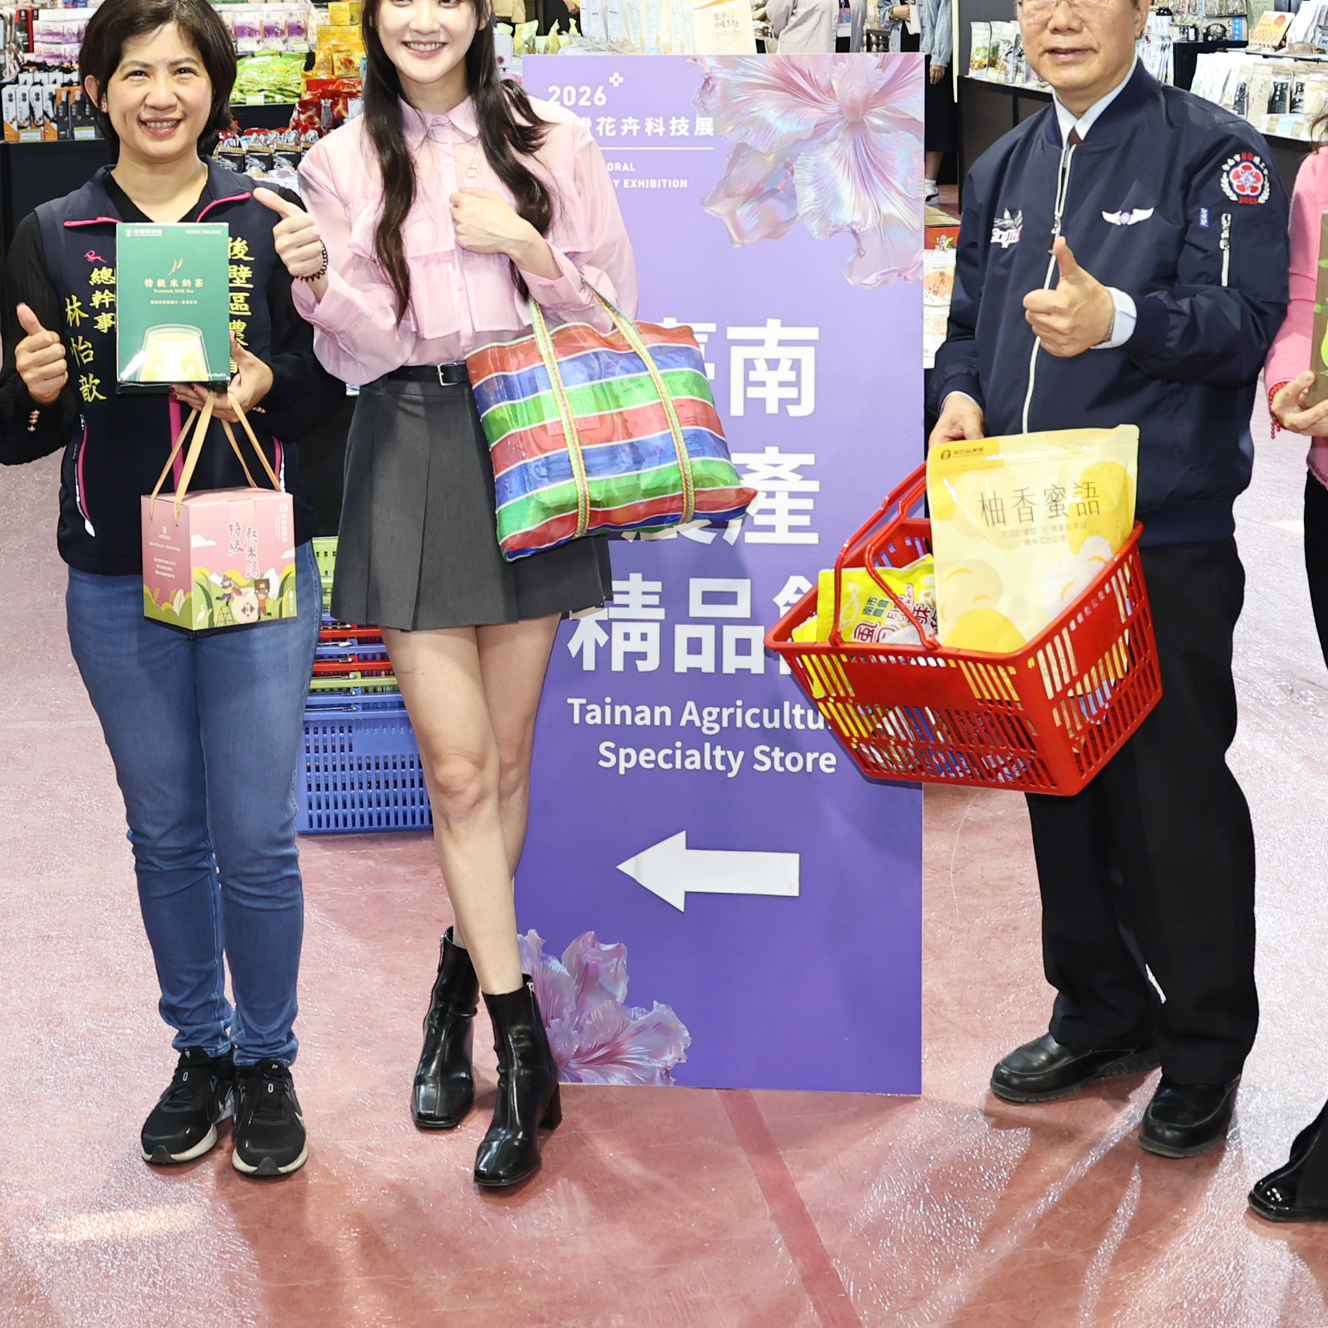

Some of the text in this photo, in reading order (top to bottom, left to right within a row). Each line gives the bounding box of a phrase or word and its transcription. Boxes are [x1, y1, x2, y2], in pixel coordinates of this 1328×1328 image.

[547, 85, 608, 107] 2026
[579, 116, 715, 137] 花卉科技展
[607, 162, 636, 172] ORAL
[623, 179, 688, 189] EXHIBITION
[144, 278, 204, 289] 特級米奶茶
[89, 266, 116, 334] 總幹事
[978, 481, 1100, 527] 柚香蜜語
[567, 698, 833, 736] Tainan Agricultu
[598, 741, 837, 778] Specialty Store
